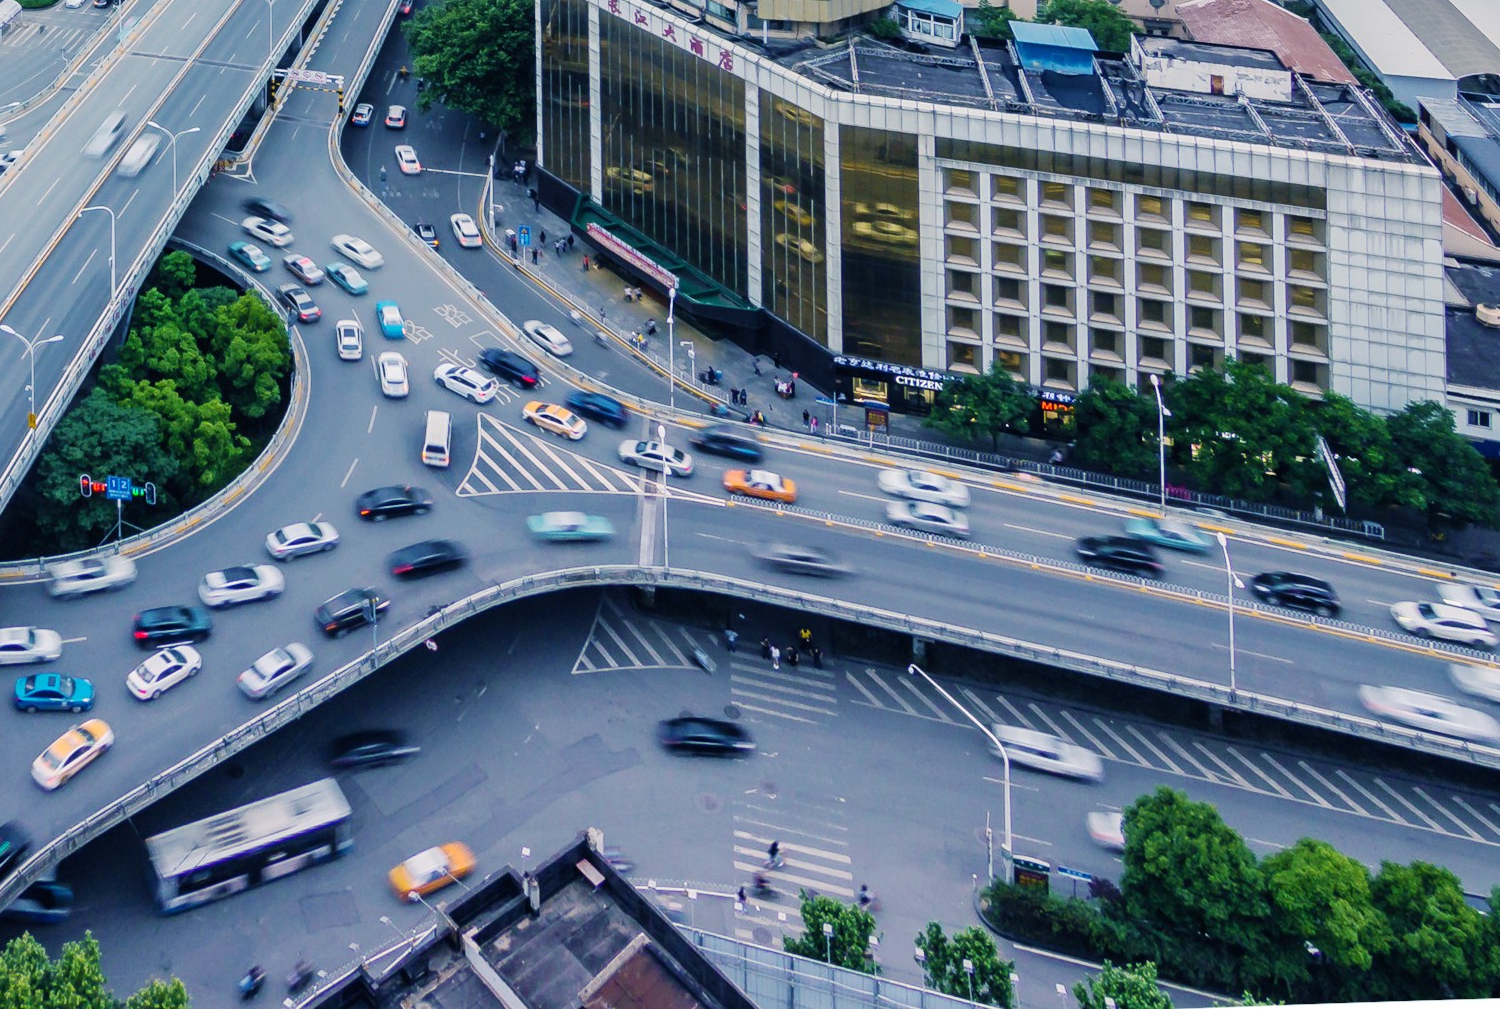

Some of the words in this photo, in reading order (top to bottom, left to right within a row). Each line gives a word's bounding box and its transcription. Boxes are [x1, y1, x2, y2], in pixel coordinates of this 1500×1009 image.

[895, 375, 944, 391] CITIZEN
[111, 479, 116, 488] 1
[121, 480, 127, 489] 2
